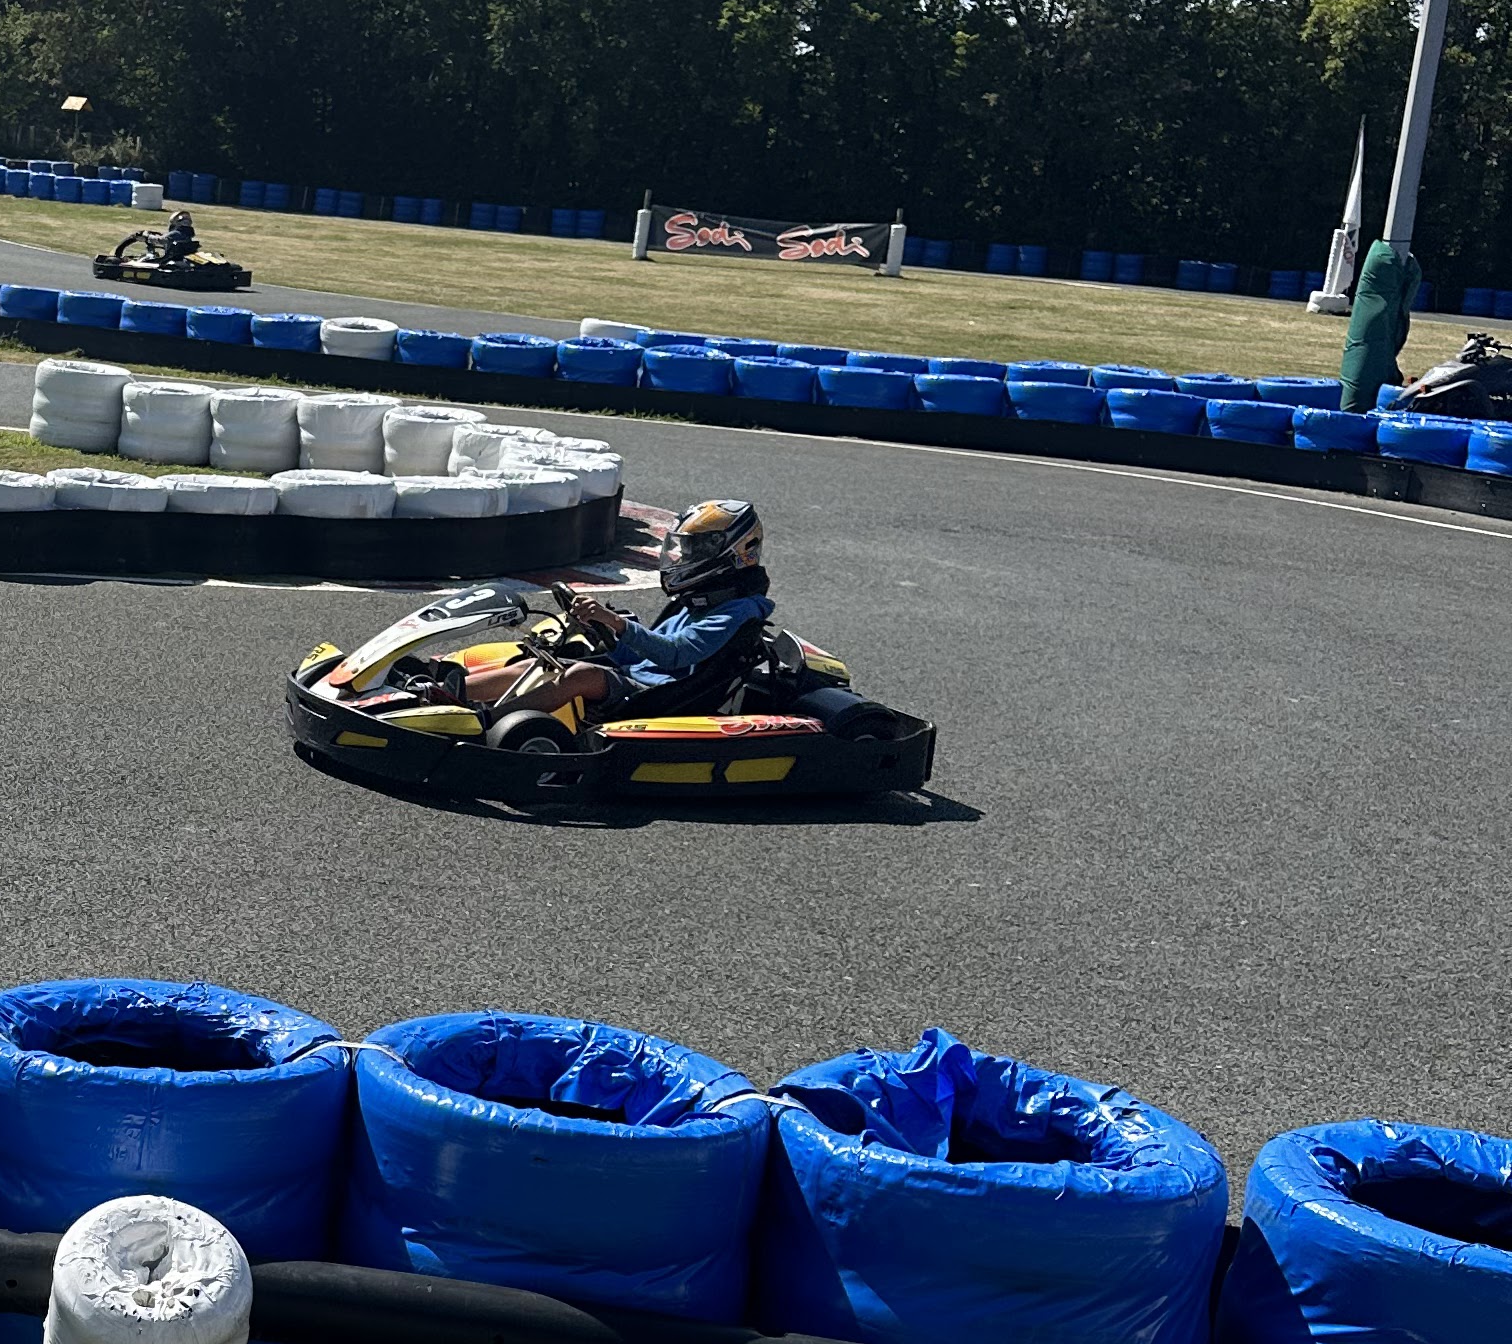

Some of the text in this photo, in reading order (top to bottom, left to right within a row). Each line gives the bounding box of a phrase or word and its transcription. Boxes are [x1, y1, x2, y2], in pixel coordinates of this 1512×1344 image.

[664, 211, 870, 261] Sodi Sodi
[446, 588, 496, 610] 3
